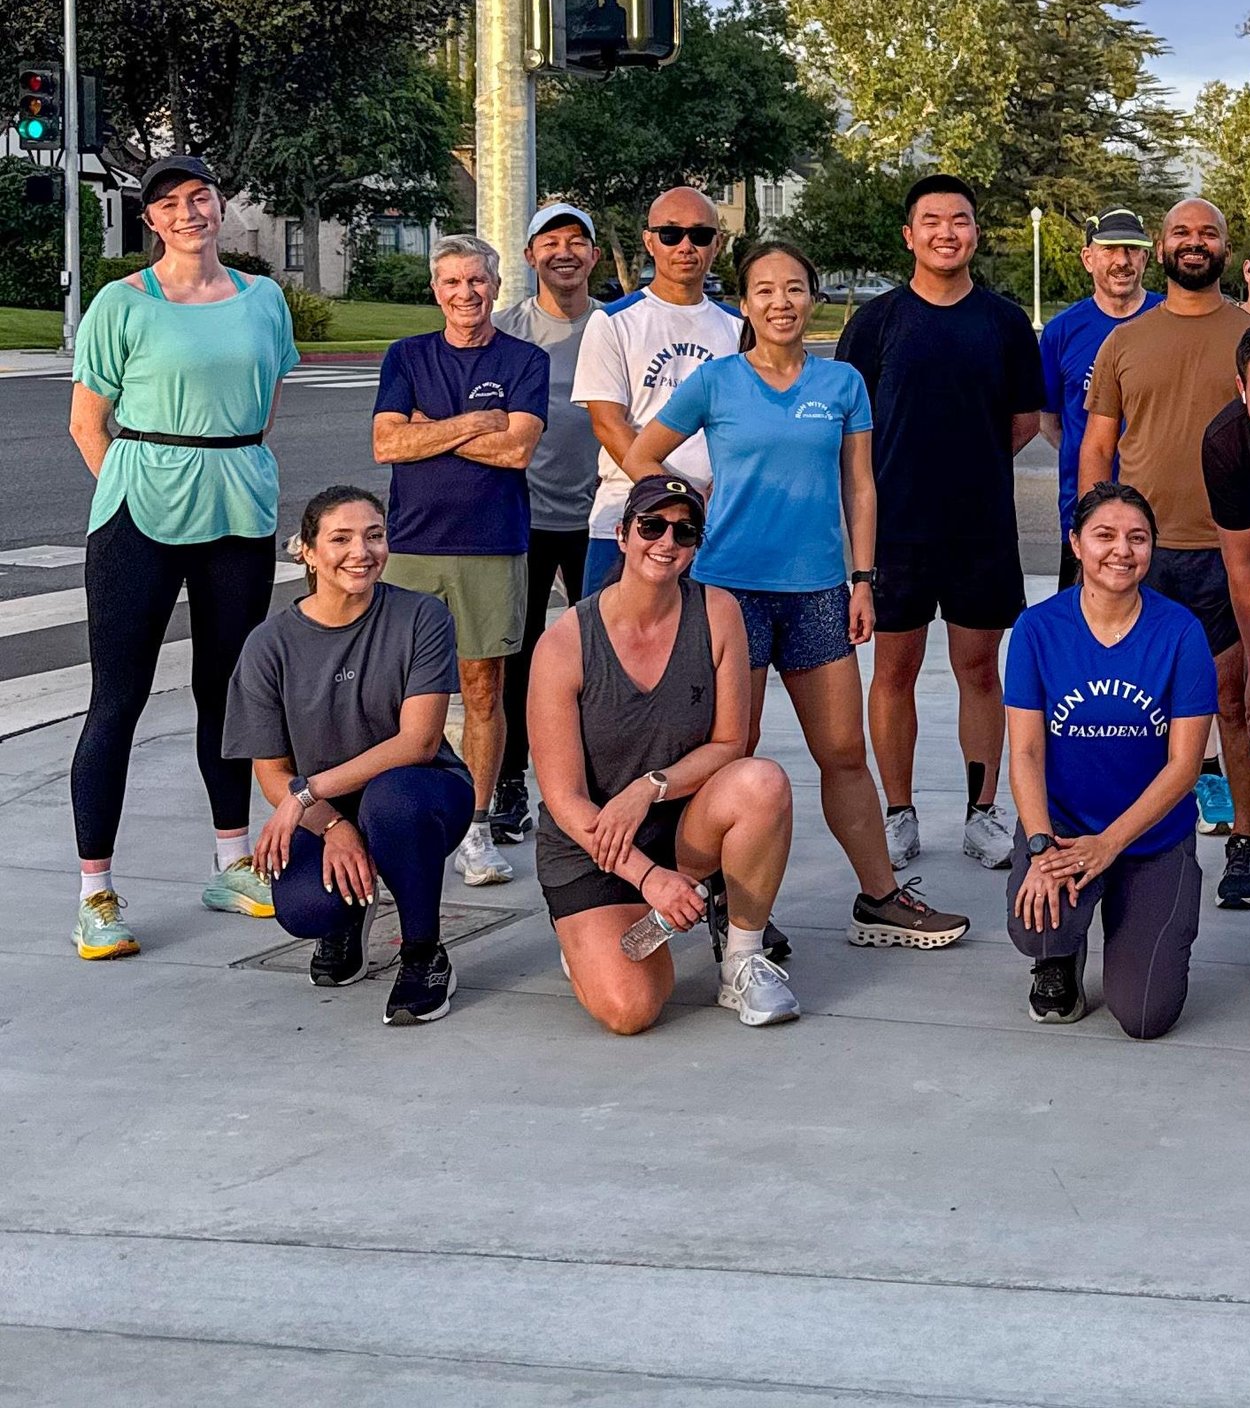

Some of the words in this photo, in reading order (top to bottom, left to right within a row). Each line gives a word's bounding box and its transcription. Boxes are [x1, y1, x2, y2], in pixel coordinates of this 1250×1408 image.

[643, 348, 673, 388] RUN
[795, 403, 806, 419] RUN
[806, 401, 828, 411] WITH
[335, 667, 355, 682] alo
[1050, 688, 1085, 737] RUN
[1087, 679, 1153, 711] WITH
[1149, 708, 1168, 737] US
[1067, 725, 1148, 738] PASADENA
